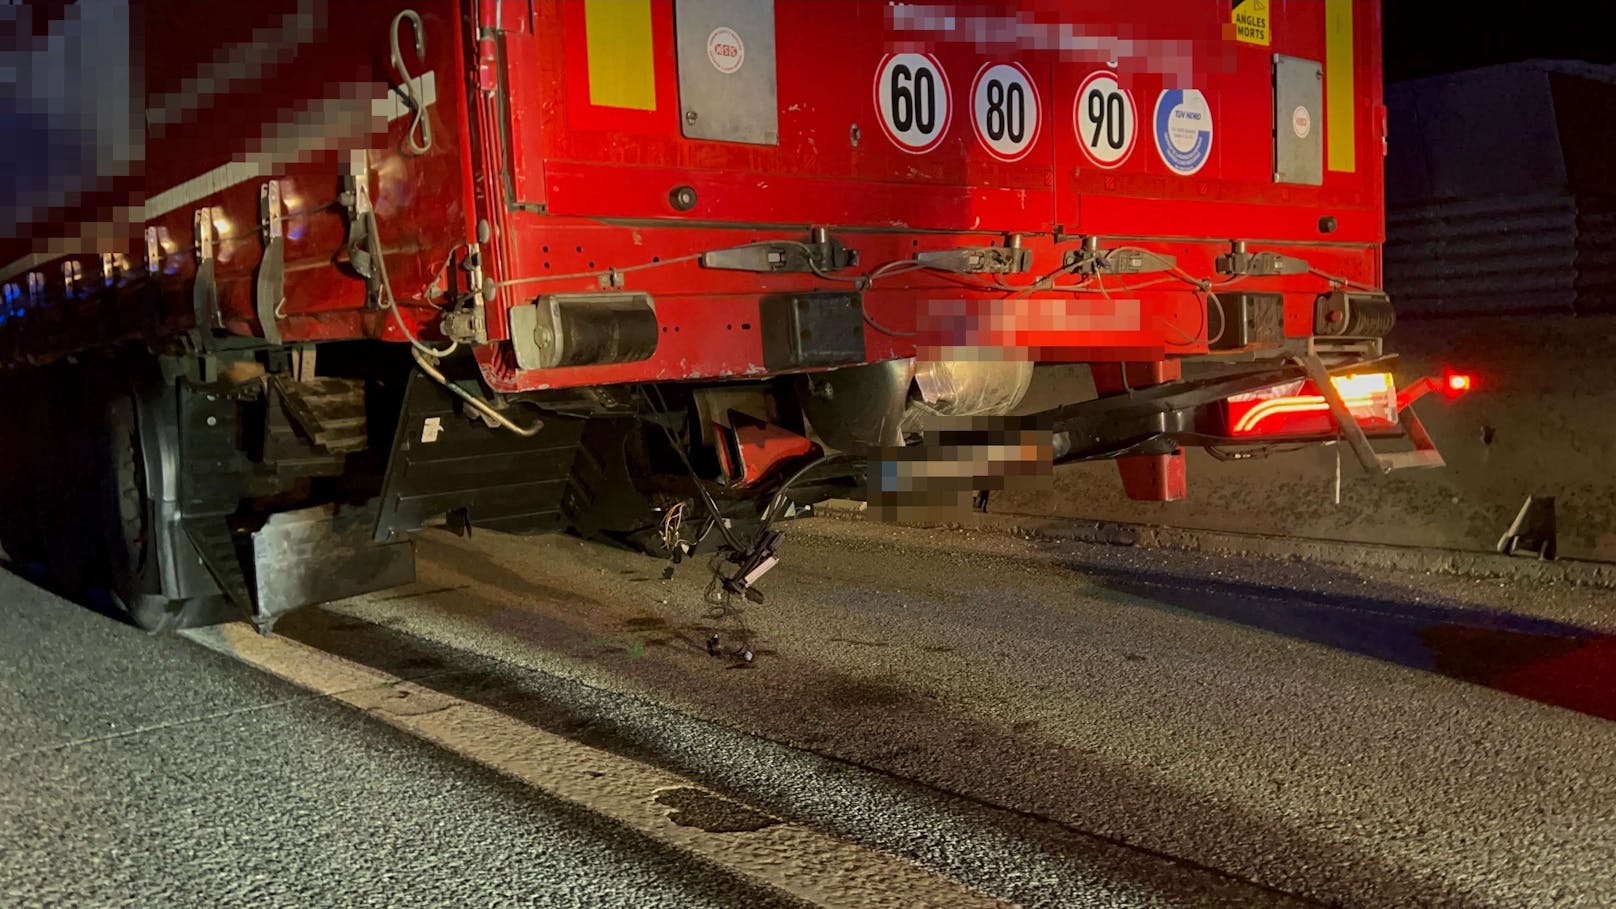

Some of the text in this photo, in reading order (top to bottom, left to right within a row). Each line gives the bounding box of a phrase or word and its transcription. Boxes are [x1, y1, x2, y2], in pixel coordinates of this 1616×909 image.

[1236, 13, 1265, 28] ANGLES
[1237, 26, 1265, 40] MORTS
[891, 63, 935, 134] 60
[986, 79, 1024, 144] 80
[1087, 88, 1125, 149] 90
